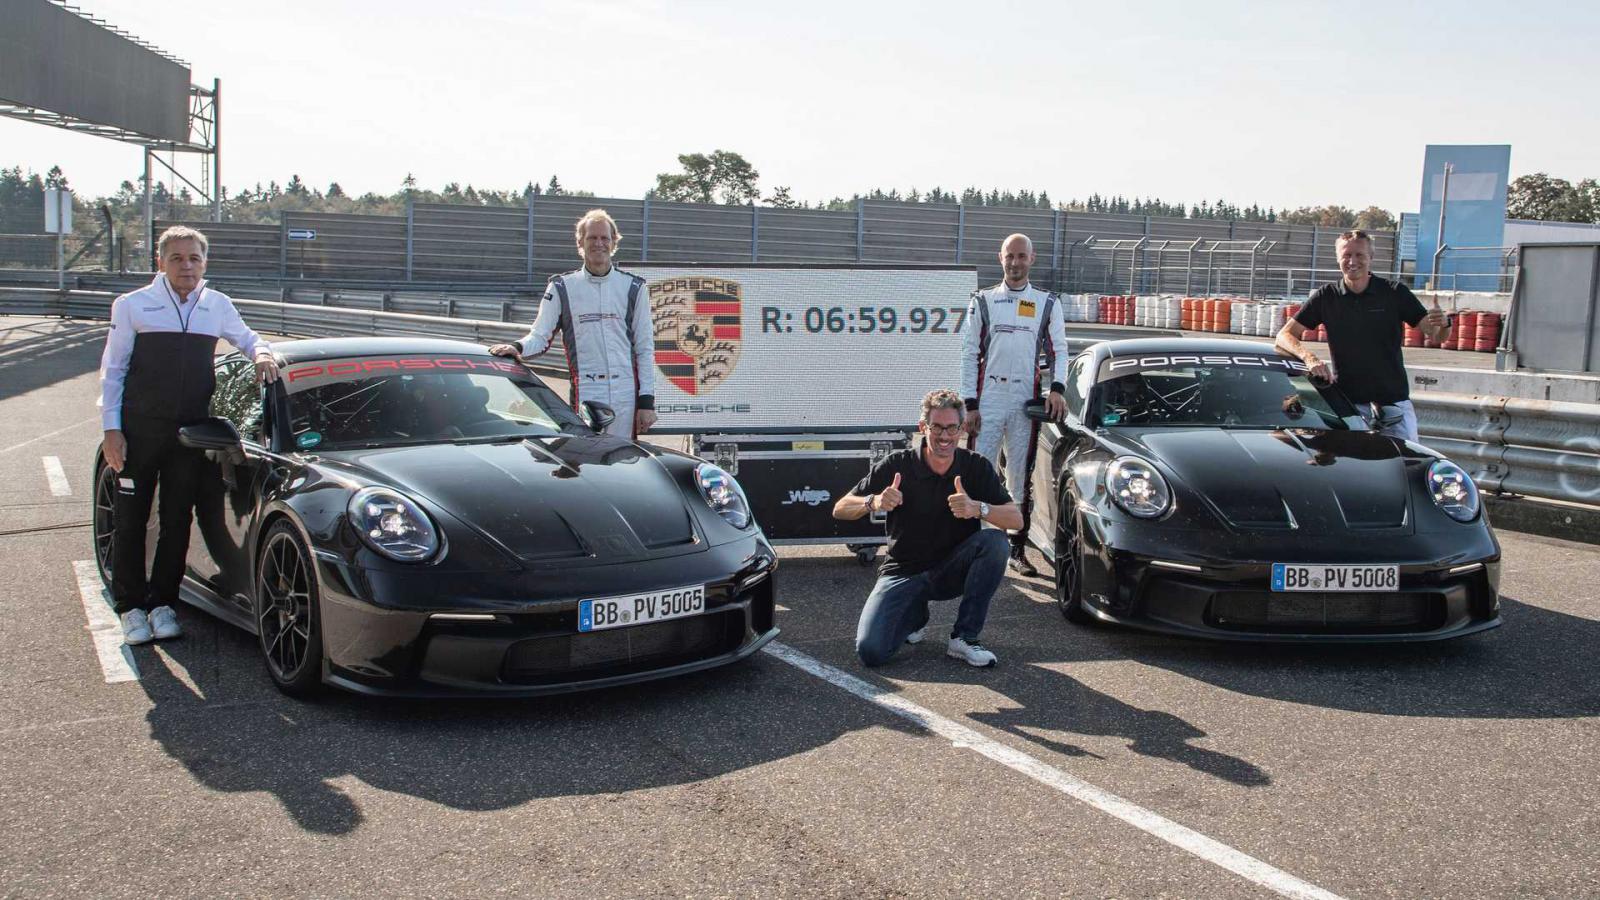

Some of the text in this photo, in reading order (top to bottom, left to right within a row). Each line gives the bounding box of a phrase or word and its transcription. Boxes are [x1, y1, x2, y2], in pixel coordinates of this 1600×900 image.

[649, 279, 738, 297] PORSCHE
[761, 306, 967, 333] R: 06:59.927
[288, 358, 527, 383] PORSCHE
[1109, 355, 1311, 372] PORSCHE
[657, 404, 751, 413] ORSCHE
[1286, 567, 1309, 588] BB
[1324, 567, 1348, 588] PV
[1351, 567, 1396, 588] 5008
[594, 602, 618, 626] BB
[634, 596, 656, 620] PV
[661, 589, 702, 615] 5005
